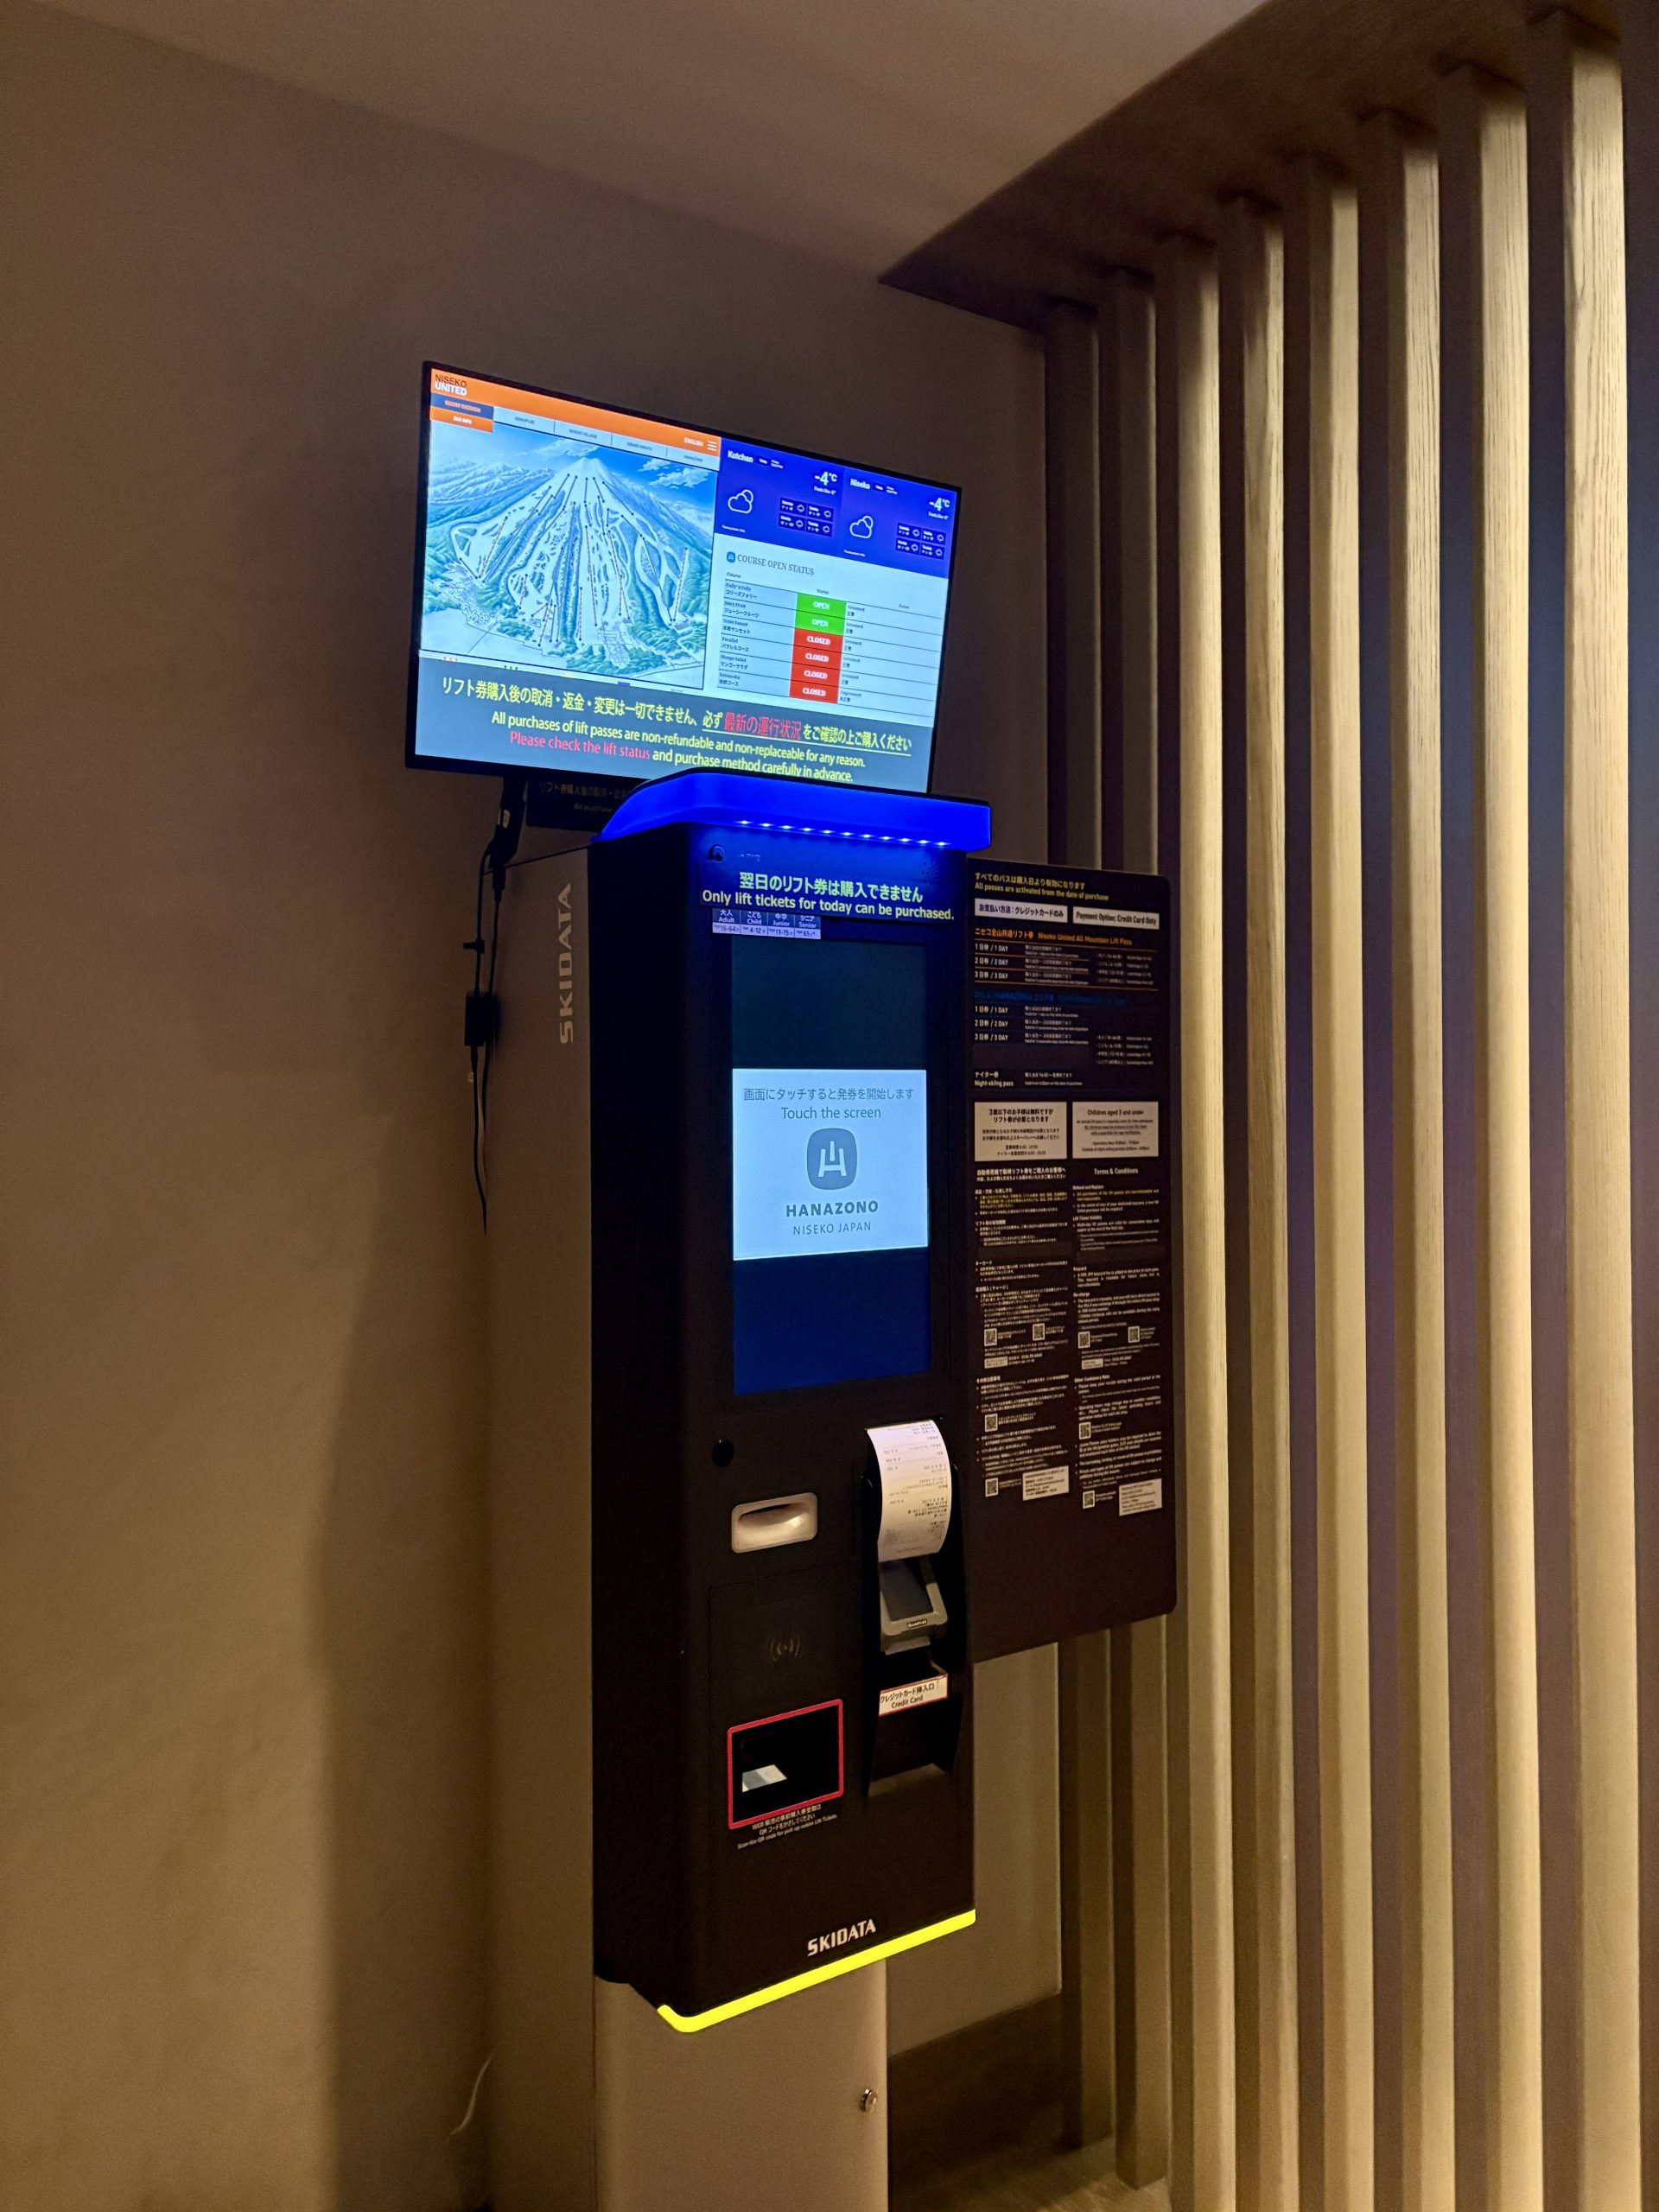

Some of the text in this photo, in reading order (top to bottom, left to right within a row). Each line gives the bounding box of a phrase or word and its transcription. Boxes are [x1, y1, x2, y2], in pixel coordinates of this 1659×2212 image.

[435, 374, 467, 387] NISEKO
[435, 382, 467, 396] UNITED
[728, 450, 753, 463] Kutchan
[850, 478, 870, 490] Niseko
[737, 554, 815, 575] COURSE OPEN STATUS
[812, 601, 830, 610] OPEN
[811, 619, 829, 627] OPEN
[806, 636, 830, 645] CLOSED
[805, 652, 830, 663] CLOSED
[804, 670, 828, 680] CLOSED
[803, 687, 826, 697] CLOSED
[492, 712, 866, 768] All purchases of lift passes are non-refundable and non-replaceable for any reason.
[510, 731, 854, 782] Please check the lift status and purchase method carefully in advance.
[739, 871, 924, 903] 翌日のリフト券は購入できません
[975, 882, 983, 891] All
[984, 885, 1003, 893] passes
[1015, 886, 1040, 896] activated
[1041, 887, 1055, 897] from
[1065, 890, 1077, 899] date
[702, 889, 955, 920] Only lift tickets for today can be purchased.
[1076, 911, 1098, 922] Payment
[1117, 914, 1133, 924] Credit
[1133, 916, 1145, 925] Card
[1146, 917, 1157, 926] Only
[557, 882, 574, 1045] SKIDATA
[743, 1088, 914, 1102] 画面にタッチすると発券を開始します
[781, 1106, 881, 1119] Touch the screen
[785, 1200, 879, 1217] HANAZONO
[793, 1222, 871, 1236] NISEKO JAPAN
[891, 1695, 924, 1709] Credit Card
[807, 1918, 876, 1957] SKIDATA
